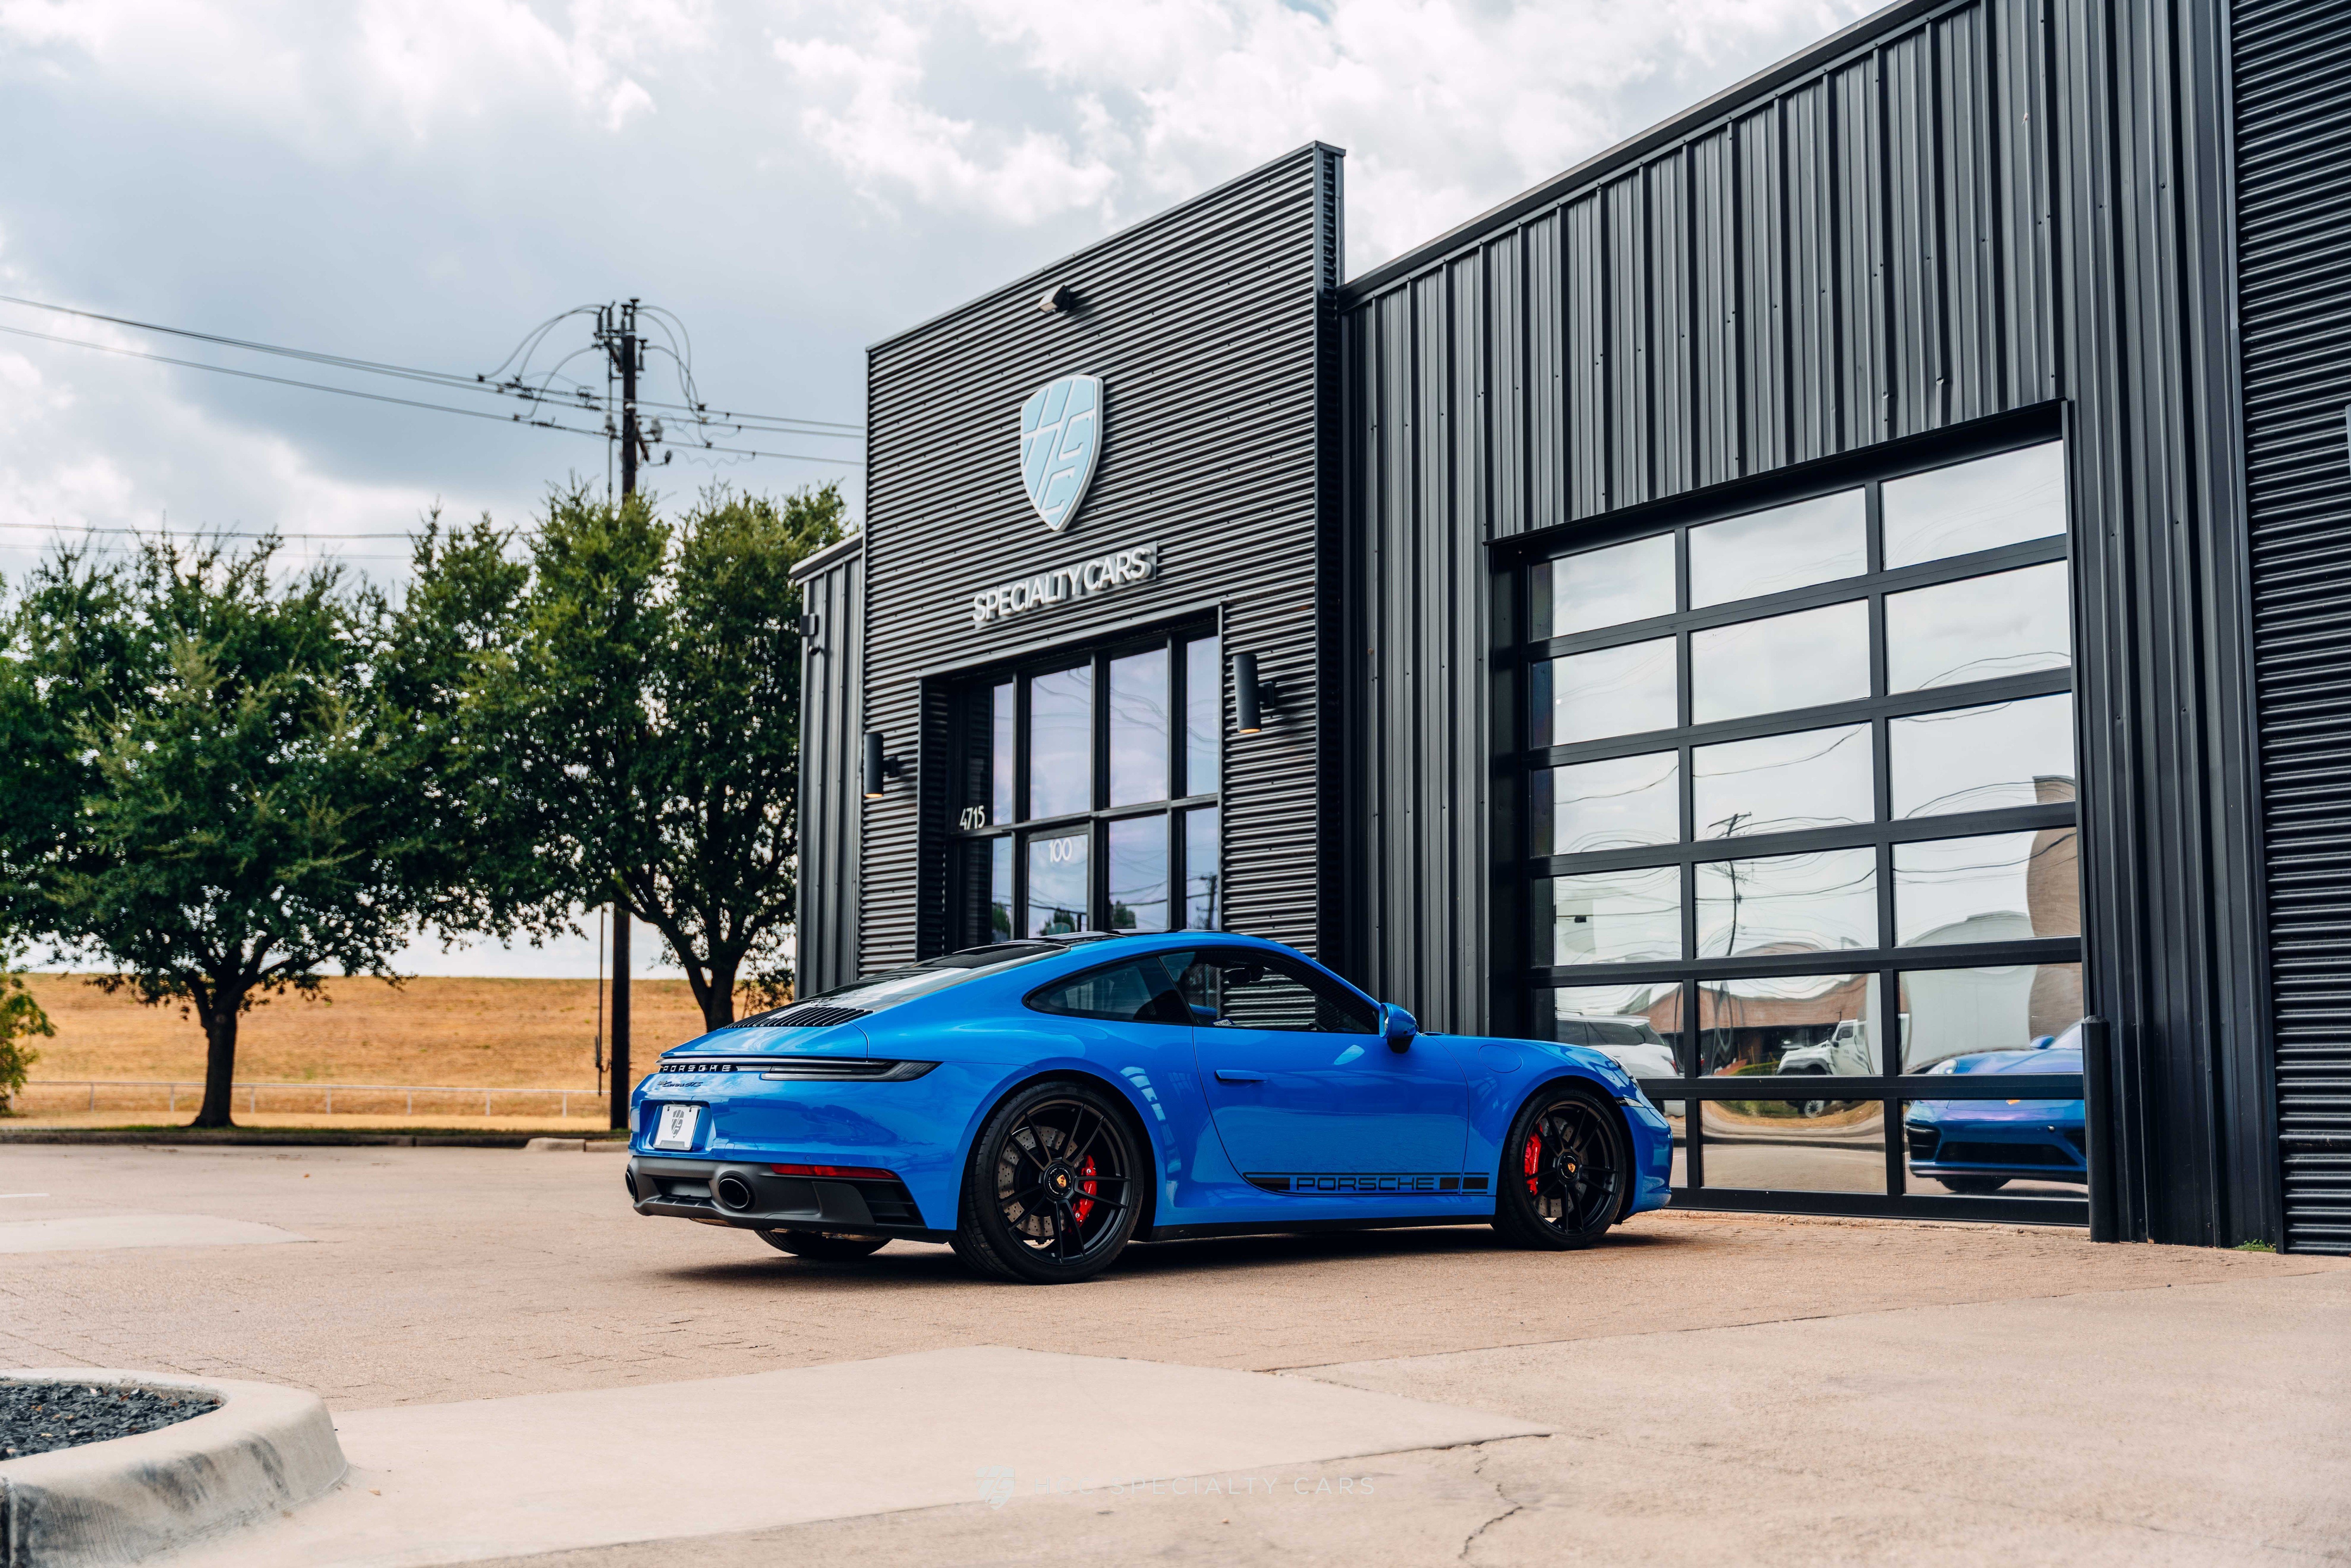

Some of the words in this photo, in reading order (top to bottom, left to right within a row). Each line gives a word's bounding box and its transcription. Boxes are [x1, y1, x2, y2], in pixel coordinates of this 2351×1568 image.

[973, 564, 1084, 622] SPECIALTY
[1084, 547, 1152, 591] CARS
[959, 805, 985, 830] 4715
[1049, 837, 1072, 862] 100
[1296, 1177, 1434, 1190] PORSCHE
